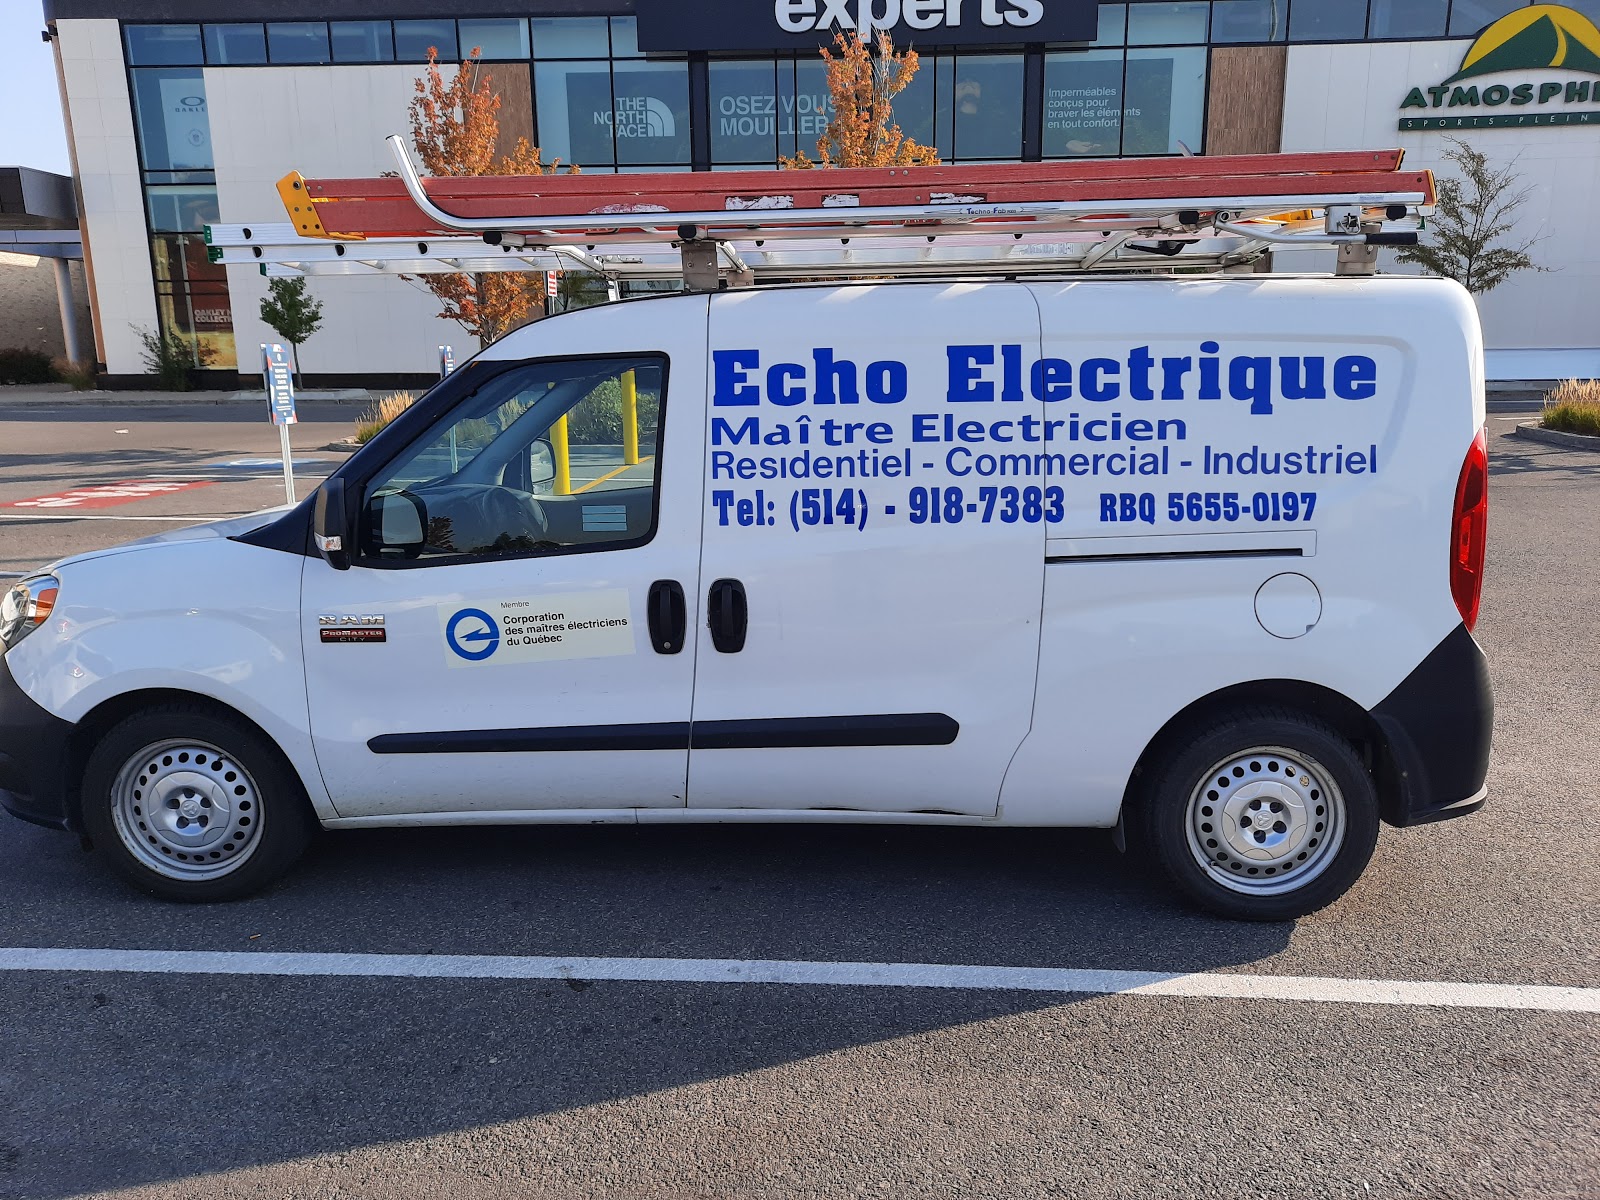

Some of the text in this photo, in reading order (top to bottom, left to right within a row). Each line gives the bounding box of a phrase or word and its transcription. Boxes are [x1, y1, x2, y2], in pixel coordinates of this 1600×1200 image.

[774, 0, 1044, 44] experts
[1048, 87, 1117, 99] Imperméables
[616, 97, 646, 111] THE
[719, 94, 836, 115] OSEZ VOUS
[1048, 99, 1109, 109] conçus pour
[593, 110, 647, 125] NORTH
[1048, 107, 1141, 118] braver les élémnts
[1047, 118, 1120, 129] en tout confort.
[609, 124, 647, 138] FACE
[712, 340, 1377, 415] Echo Electrique
[711, 412, 1187, 447] Maître Electricien
[711, 448, 911, 480] Residentiel
[945, 445, 1169, 477] Commercial
[1203, 444, 1377, 475] Industriel
[712, 489, 775, 527] Tel:
[789, 487, 869, 533] (514)
[909, 485, 1065, 525] 918-7383
[1099, 491, 1317, 525] RBQ 5655-0197
[500, 601, 530, 609] Membre
[318, 614, 385, 625] RAM
[503, 612, 565, 625] Corporation
[505, 618, 628, 636] des maîtres électriciens
[506, 634, 563, 646] du Québec
